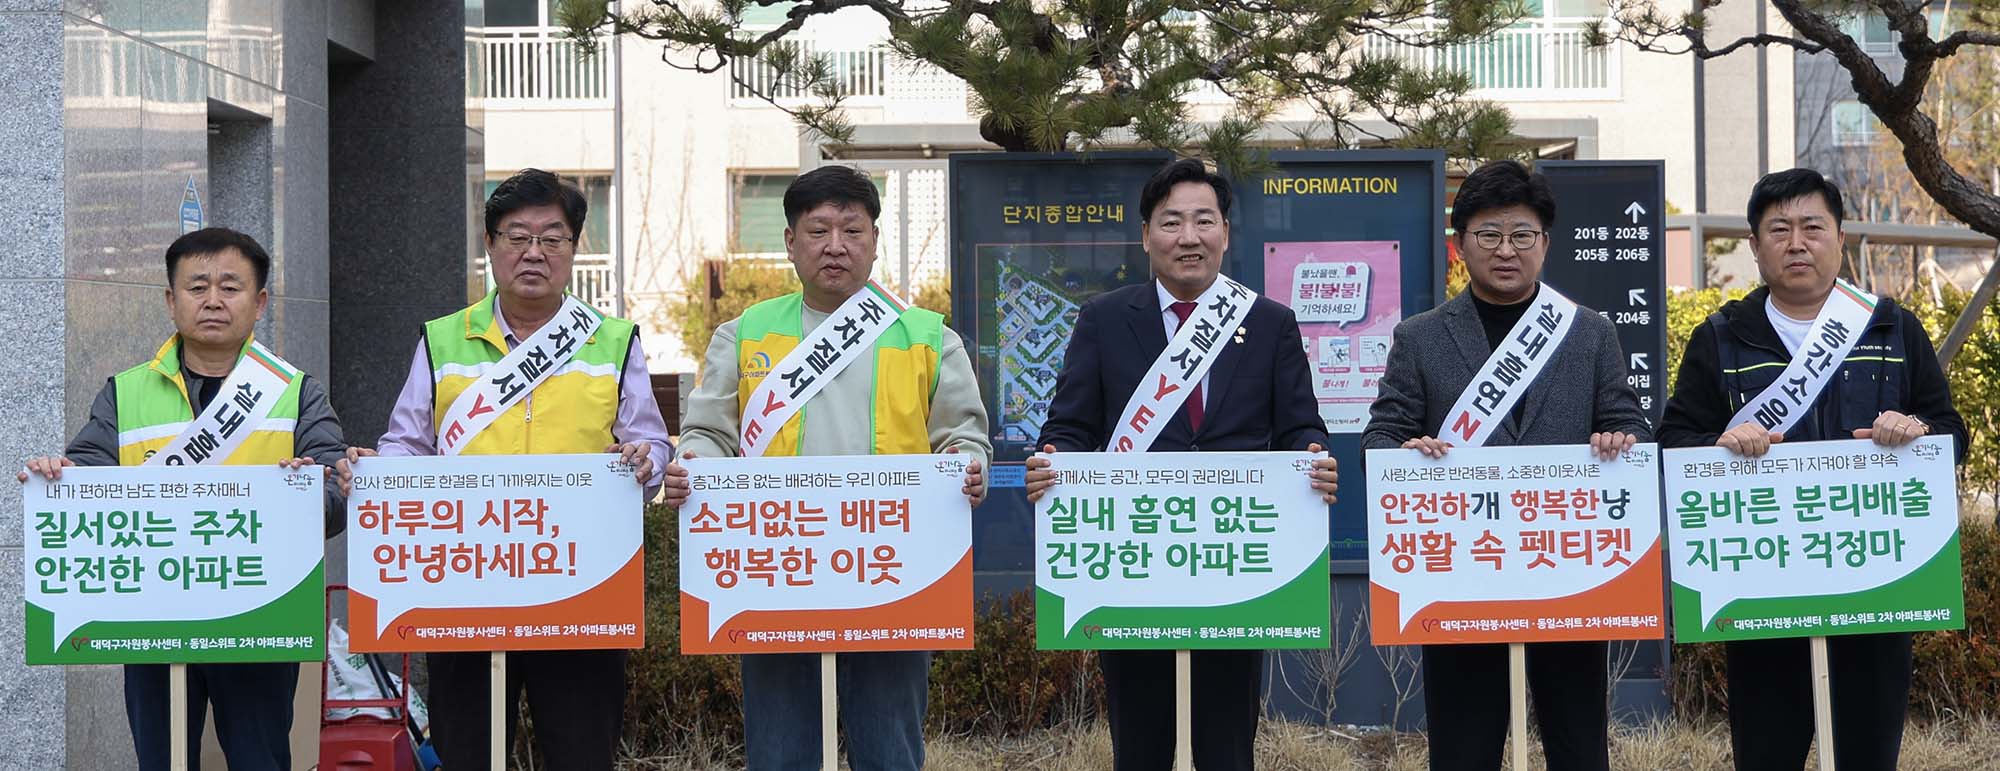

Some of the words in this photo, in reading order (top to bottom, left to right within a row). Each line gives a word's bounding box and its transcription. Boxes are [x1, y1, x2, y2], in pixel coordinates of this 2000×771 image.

[1263, 177, 1397, 194] INFORMATION
[1003, 204, 1125, 224] 단지종합안내
[1574, 227, 1609, 240] 201동
[1615, 227, 1650, 240] 202동
[1574, 248, 1609, 261] 205동
[1615, 248, 1650, 261] 206동
[1301, 303, 1356, 315] 기억하세요!
[1615, 311, 1650, 325] 204동
[1170, 280, 1248, 381] 주차질서
[492, 306, 593, 406] 주차질서
[781, 298, 886, 400] 주차질서
[1472, 302, 1563, 416] 실내흡연
[1627, 375, 1650, 388] 이집
[1753, 318, 1850, 431] 층간소음
[438, 392, 495, 456] YE
[739, 389, 786, 457] YE
[1114, 373, 1180, 452] YES
[1445, 410, 1482, 447] N
[354, 475, 380, 489] 인사
[384, 475, 436, 489] 한마디로
[439, 474, 478, 489] 한걸음
[482, 475, 494, 488] 더
[499, 474, 563, 488] 가까워지는
[567, 473, 592, 487] 이웃
[693, 475, 749, 490] 층간소음
[753, 474, 782, 489] 없는
[785, 473, 843, 488] 배려하는
[846, 472, 875, 488] 우리
[879, 471, 920, 487] 아파트
[1054, 470, 1107, 485] 함께사는
[1110, 470, 1142, 486] 공간,
[1146, 470, 1189, 484] 모두의
[1192, 470, 1264, 485] 권리입니다
[1381, 467, 1446, 482] 사랑스러운
[1449, 466, 1504, 481] 반려동물,
[1507, 465, 1546, 479] 소중한
[1549, 464, 1600, 478] 이웃사촌
[1684, 463, 1726, 478] 환경을
[1729, 461, 1758, 476] 위해
[1761, 459, 1804, 474] 모두가
[1807, 457, 1850, 472] 지켜야
[1853, 455, 1867, 469] 할
[1871, 453, 1899, 468] 약속
[46, 483, 75, 499] 내가
[80, 483, 123, 499] 편하면
[127, 483, 156, 498] 남도
[160, 483, 188, 498] 편한
[192, 482, 250, 497] 주차매너
[1380, 491, 1500, 524] 안전하개
[1511, 488, 1630, 522] 행복한냥
[1676, 487, 1780, 529] 올바른
[1792, 478, 1932, 522] 분리배출
[35, 510, 177, 549] 질서있는
[190, 509, 262, 546] 주차
[357, 499, 465, 535] 하루의
[478, 498, 559, 538] 시작,
[689, 499, 828, 537] 소리없는
[841, 498, 910, 533] 배려
[1046, 496, 1115, 535] 실내
[1128, 494, 1198, 535] 흡연
[1210, 496, 1279, 534] 없는
[373, 542, 576, 583] 안녕하세요!
[704, 546, 817, 588] 행복한
[831, 545, 902, 585] 이웃
[1046, 540, 1153, 580] 건강한
[1166, 542, 1273, 577] 아파트
[1380, 529, 1456, 573] 생활
[1470, 529, 1506, 571] 속
[1519, 527, 1632, 569] 펫티켓
[1686, 534, 1790, 572] 지구야
[1801, 528, 1905, 569] 걱정마
[35, 554, 145, 594] 안전한
[158, 555, 267, 590] 아파트
[416, 626, 506, 638] 대덕구자원봉사센터
[514, 625, 560, 637] 동일스위트
[563, 625, 579, 635] 2차
[581, 624, 636, 635] 아파트봉사단
[747, 630, 835, 642] 대덕구자원봉사센터
[844, 630, 889, 641] 동일스위트
[892, 629, 908, 639] 2차
[910, 628, 965, 640] 아파트봉사단
[1102, 627, 1191, 639] 대덕구자원봉사센터
[1199, 627, 1245, 638] 동일스위트
[1248, 627, 1263, 637] 2차
[1265, 627, 1321, 638] 아파트봉사단
[1441, 619, 1528, 631] 대덕구자원봉사센터
[1537, 618, 1583, 630] 동일스위트
[1586, 618, 1601, 628] 2차
[1603, 616, 1657, 627] 아파트봉사단
[1734, 616, 1822, 630] 대덕구자원봉사센터
[1829, 613, 1875, 626] 동일스위트
[1877, 612, 1893, 623] 2차
[1895, 609, 1950, 621] 아파트봉사단
[91, 638, 181, 650] 대덕구자원봉사센터
[189, 637, 237, 649] 동일스위트
[239, 637, 255, 648] 2차
[257, 636, 313, 648] 아파트봉사단
